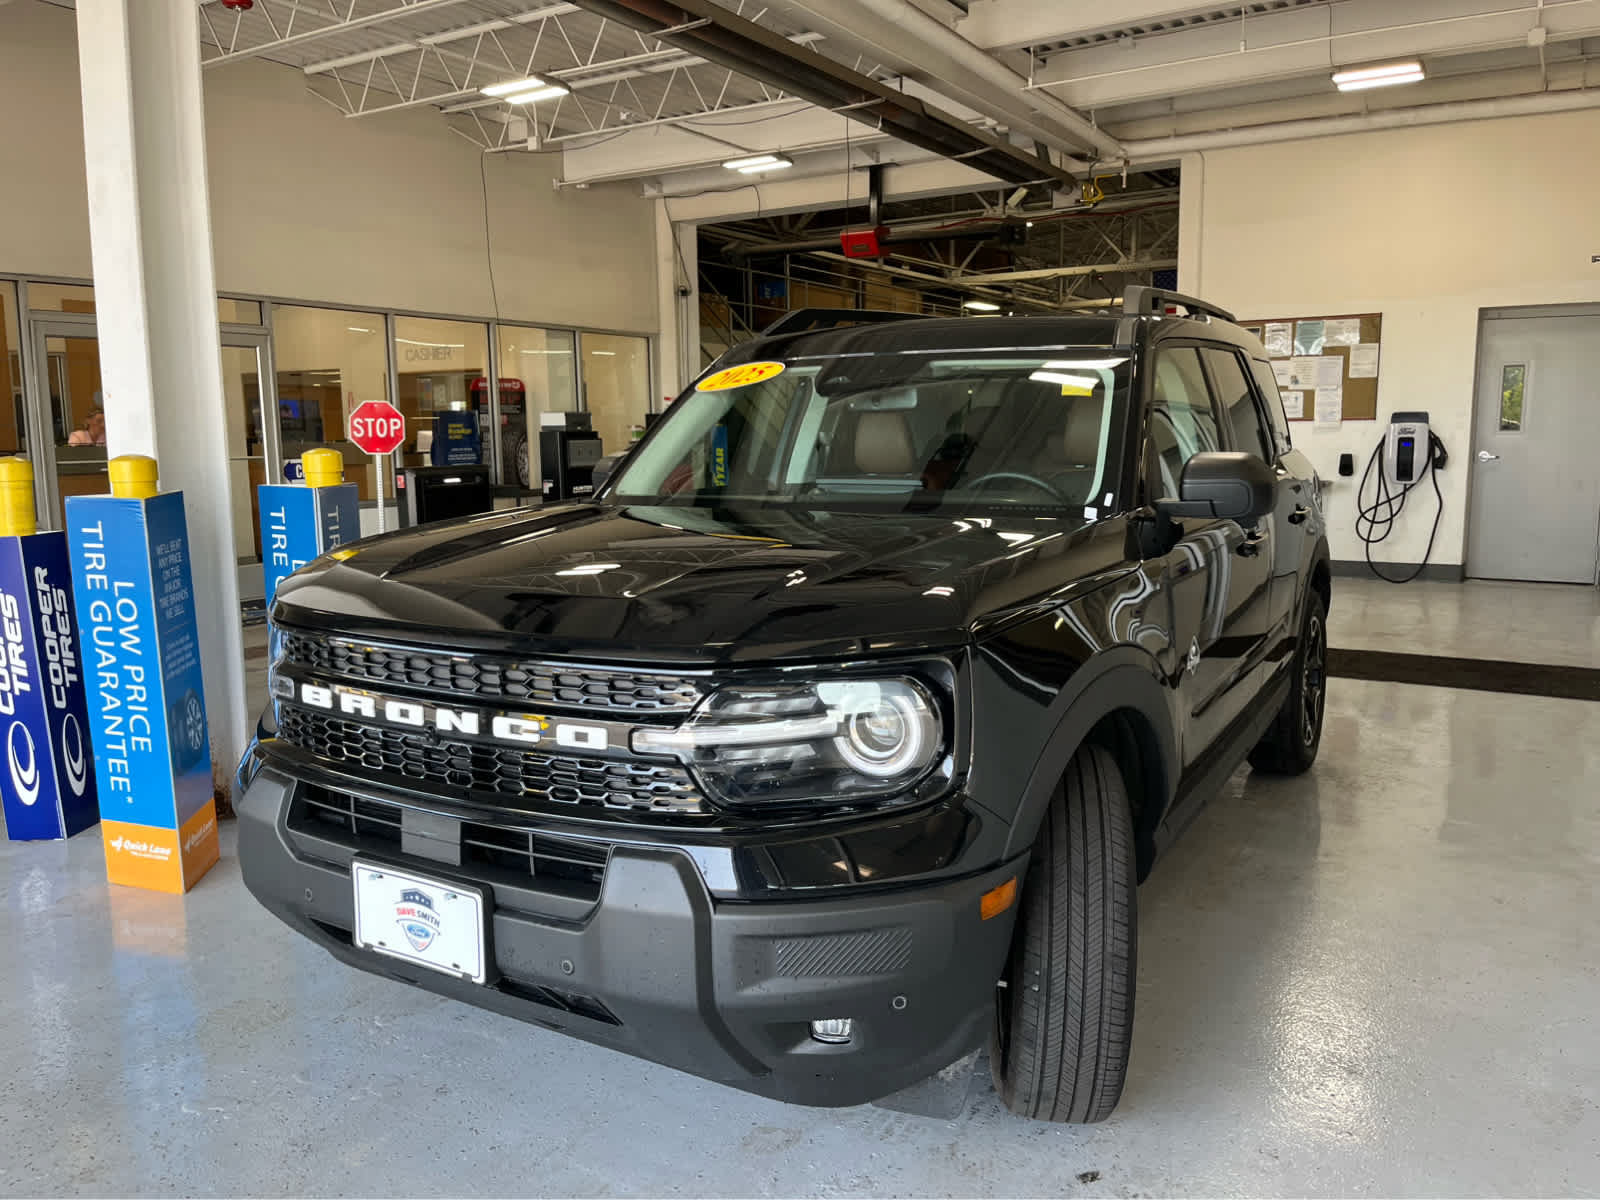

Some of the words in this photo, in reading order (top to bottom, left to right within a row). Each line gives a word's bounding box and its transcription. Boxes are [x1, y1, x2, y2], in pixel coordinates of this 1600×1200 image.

[353, 417, 401, 438] STOP
[81, 520, 109, 591] TIRE
[270, 505, 289, 567] TIRE
[327, 504, 341, 550] TIR
[1, 593, 31, 696] TIRES
[35, 566, 66, 709] COOPER
[52, 587, 78, 688] TIRES
[113, 580, 143, 656] LOW
[123, 664, 152, 753] PRICE
[301, 684, 608, 750] BRONCO
[396, 907, 416, 918] DAVE
[416, 910, 441, 929] SMITH
